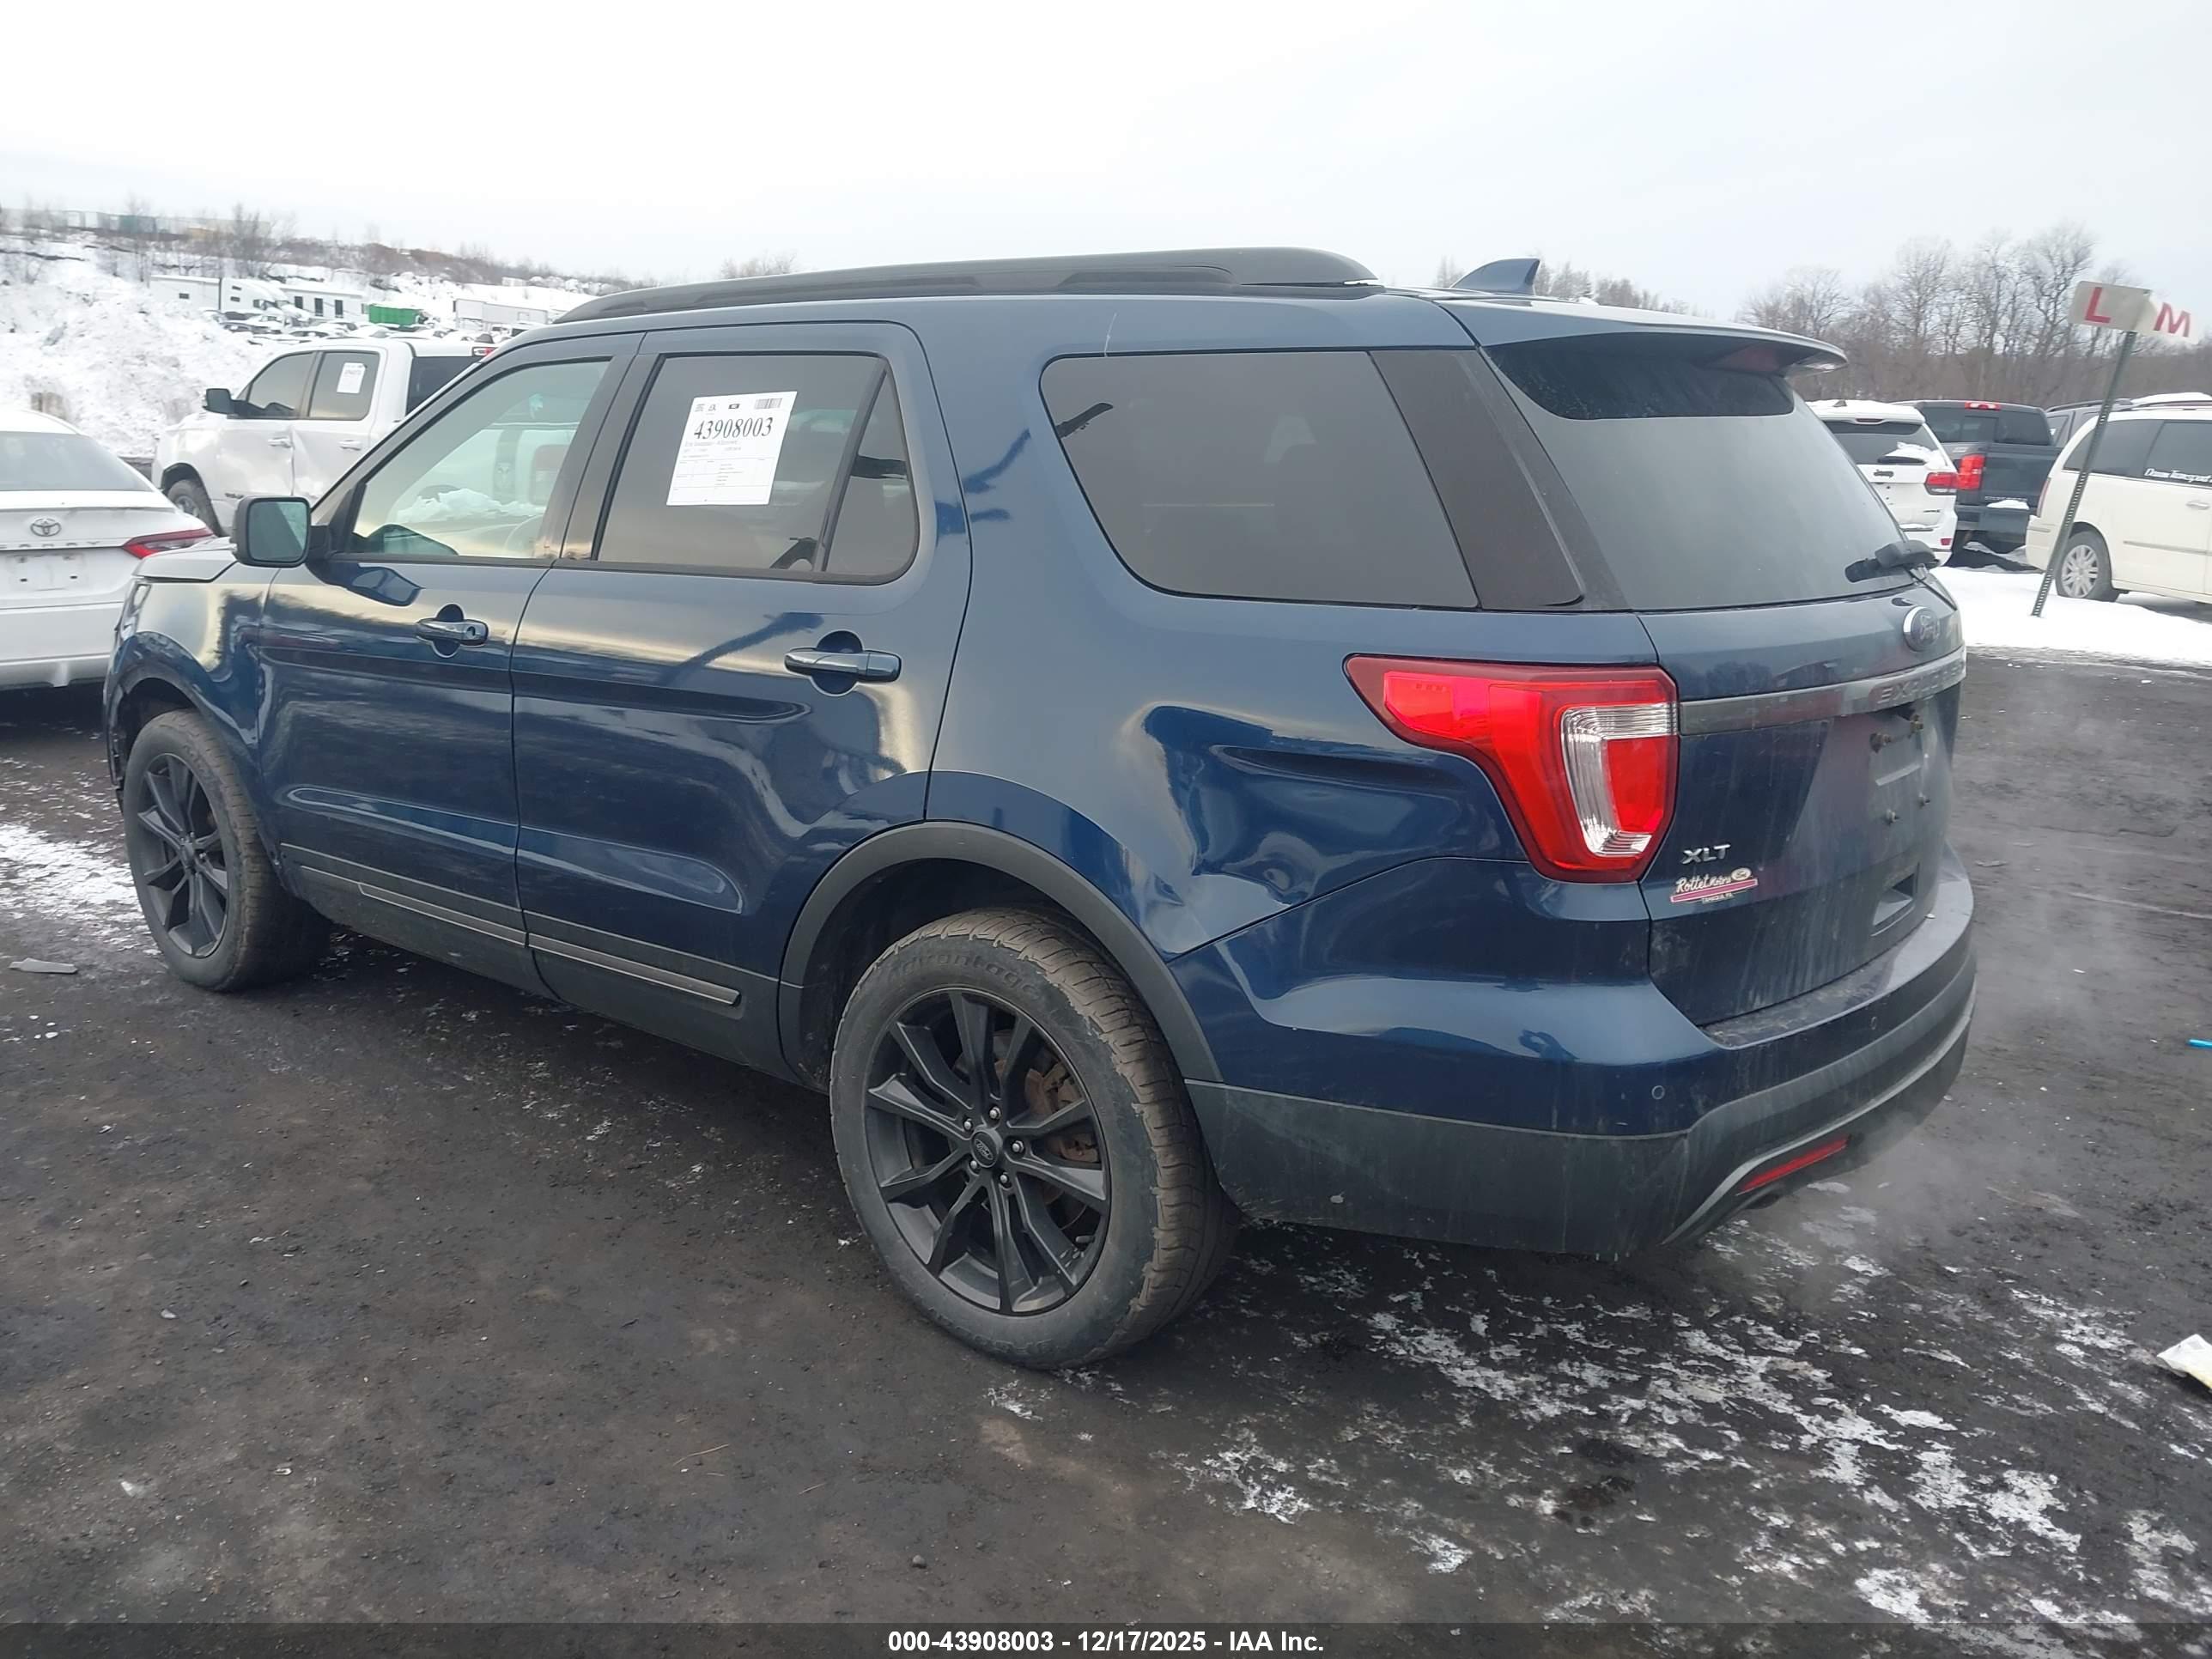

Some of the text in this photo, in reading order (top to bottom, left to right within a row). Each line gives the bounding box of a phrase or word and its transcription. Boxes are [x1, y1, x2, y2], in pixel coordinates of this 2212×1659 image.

[2084, 287, 2112, 324] L
[2153, 302, 2191, 337] M
[694, 417, 773, 440] 43908003
[1680, 843, 1732, 865] XLT
